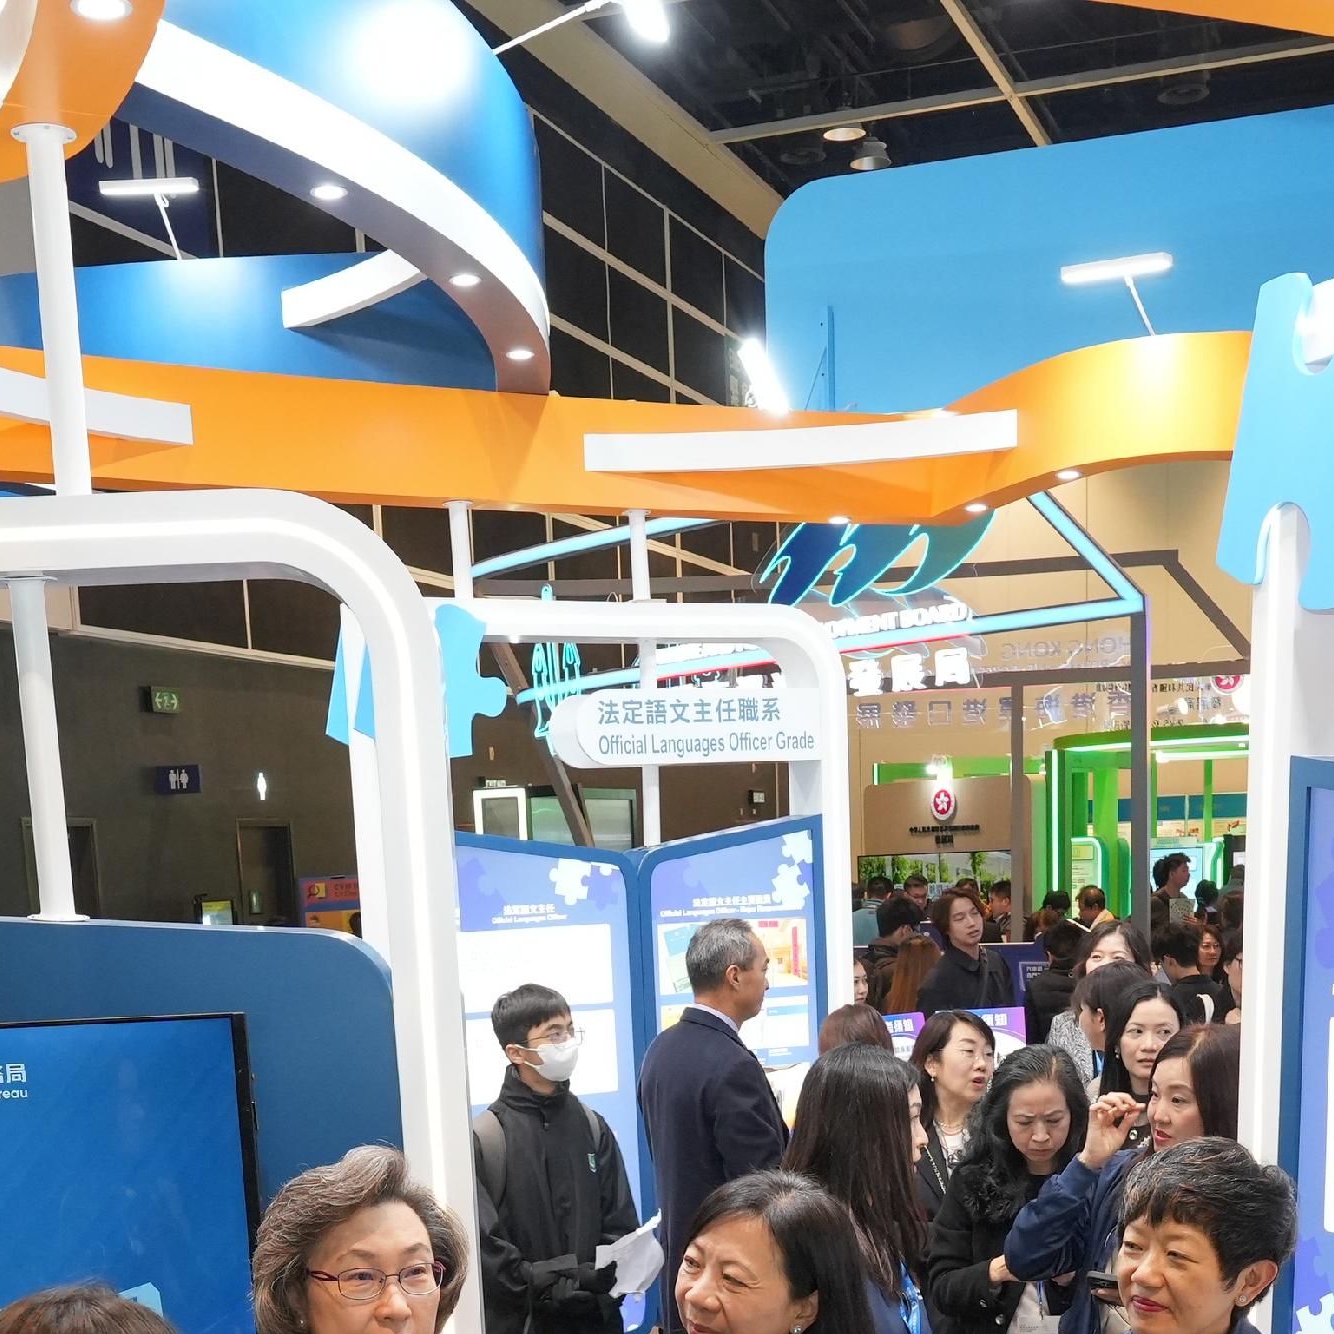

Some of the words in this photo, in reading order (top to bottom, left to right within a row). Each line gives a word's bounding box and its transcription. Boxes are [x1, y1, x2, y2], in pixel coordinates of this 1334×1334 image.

[900, 603, 969, 628] BOARD
[598, 697, 781, 725] 法定語文主任職系
[599, 733, 647, 756] Official
[651, 731, 724, 758] Languages
[729, 732, 774, 753] Officer
[776, 731, 814, 750] Grade
